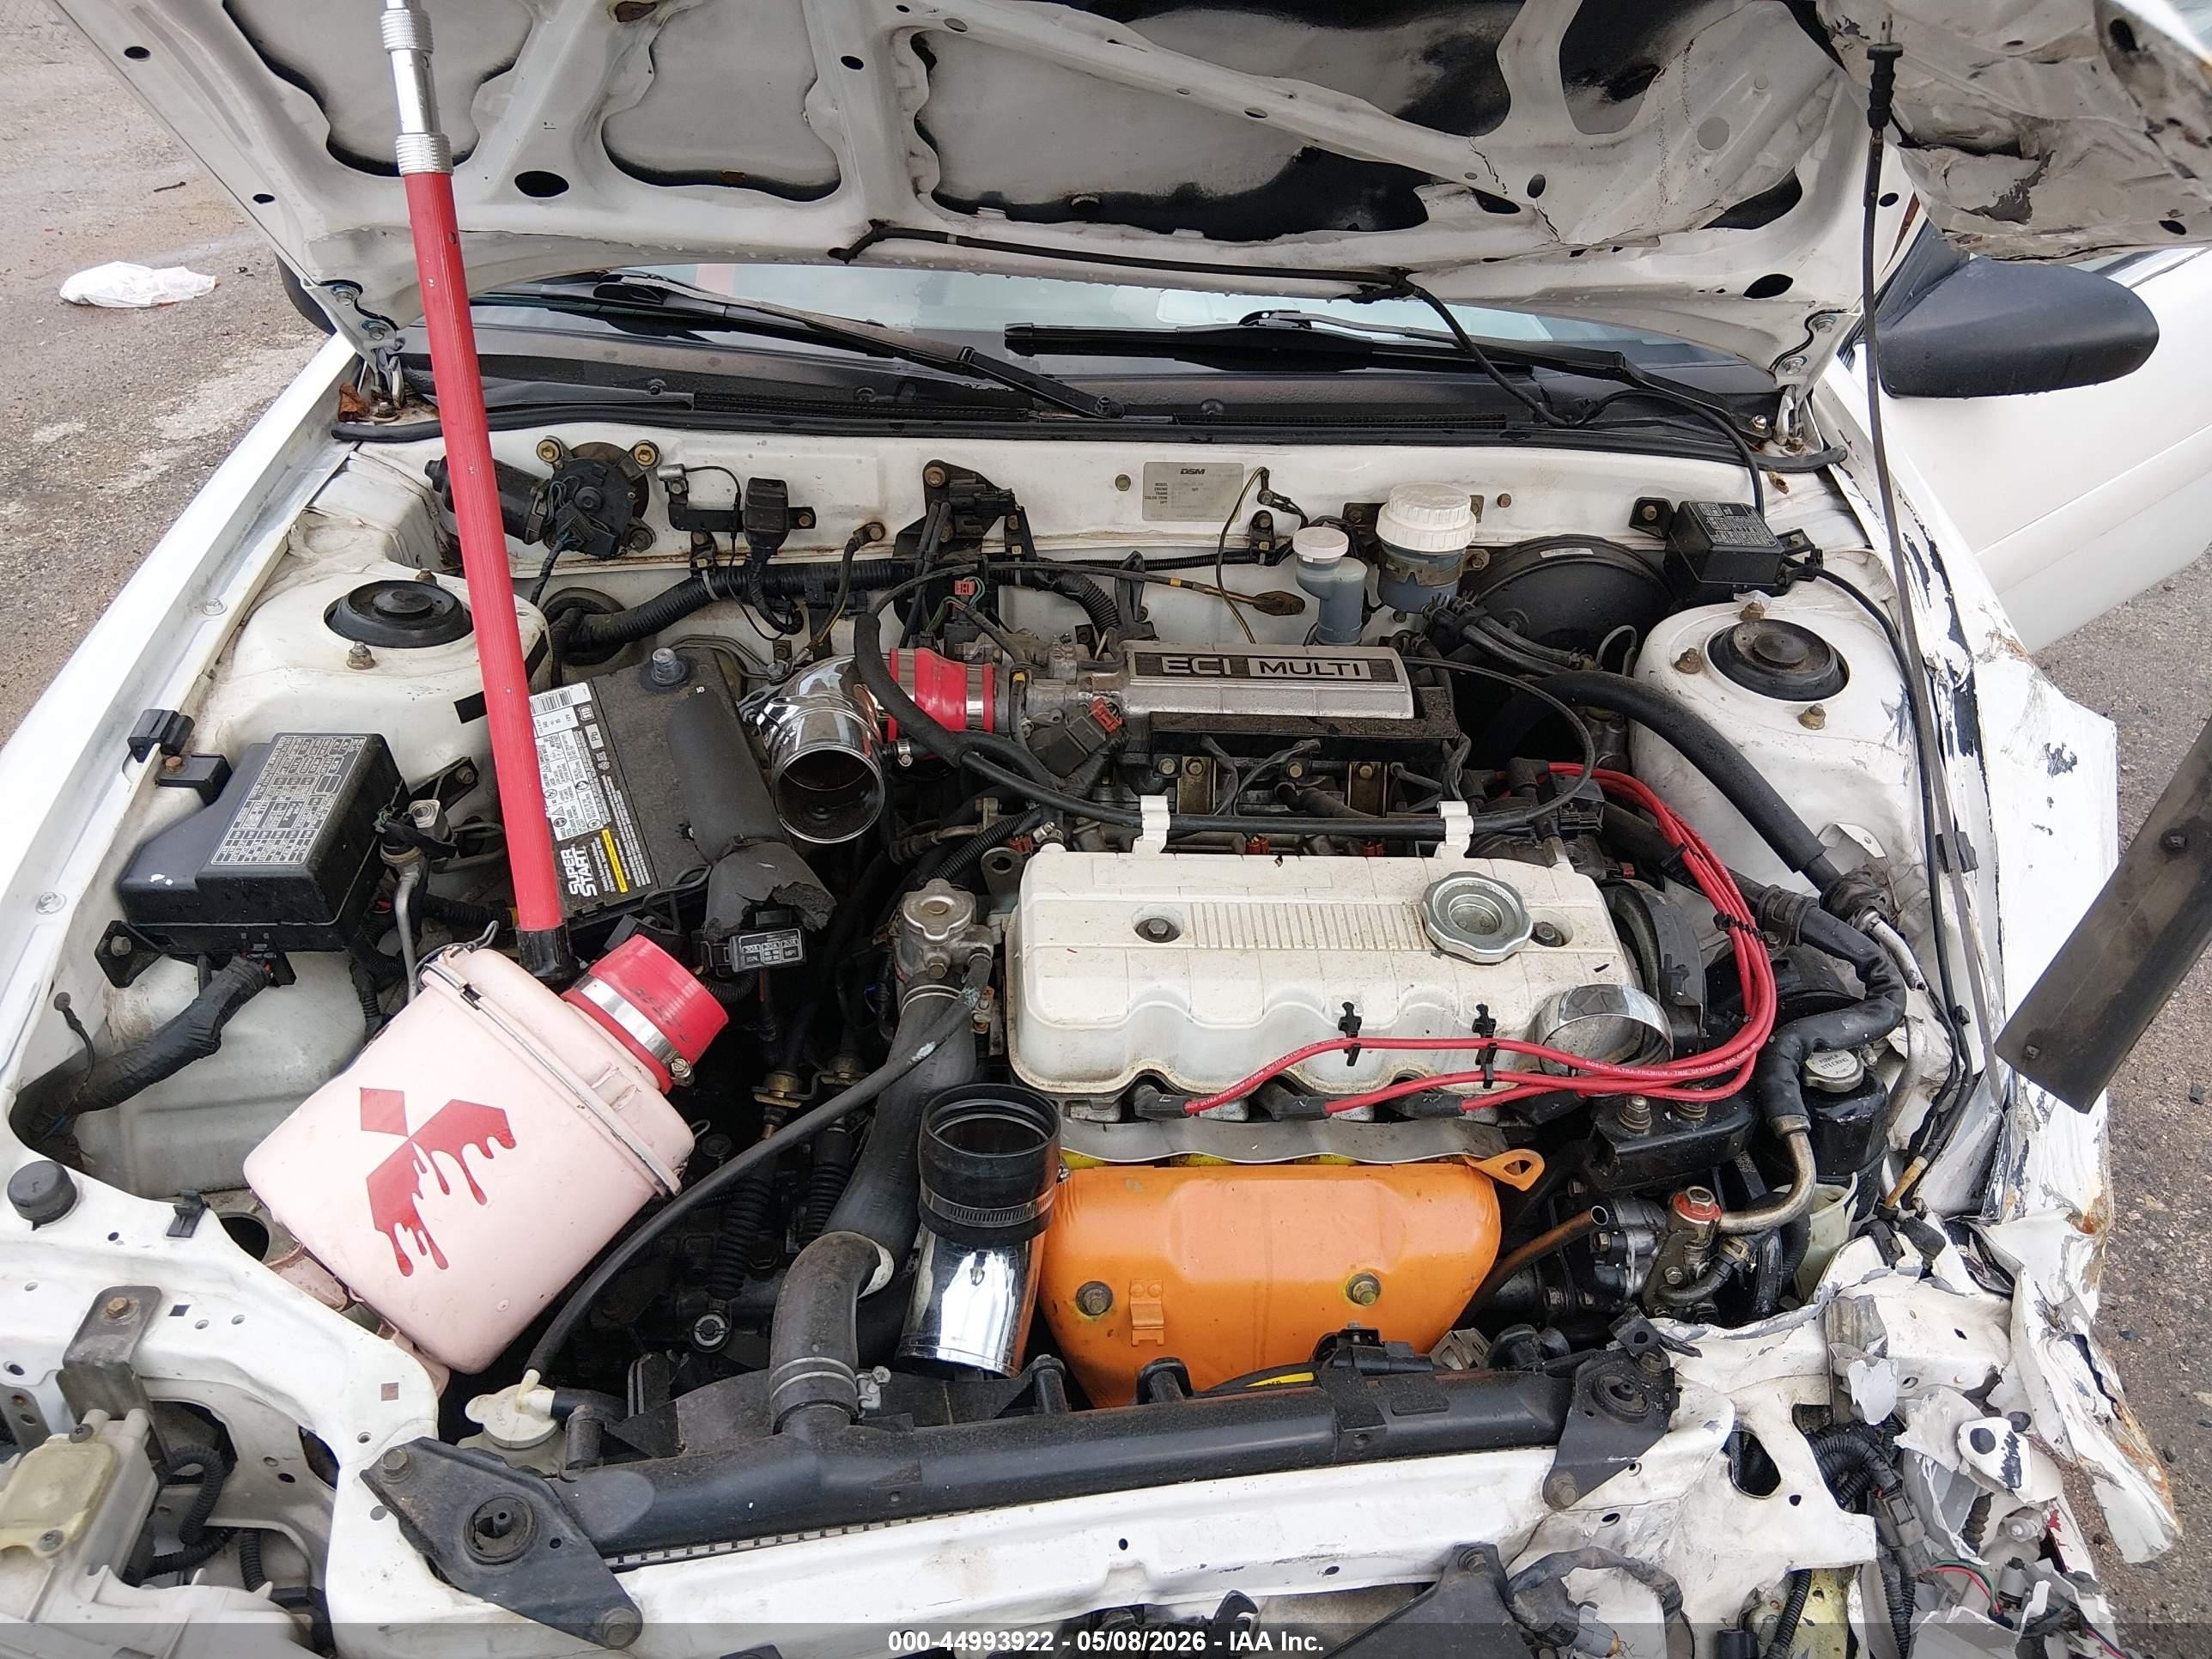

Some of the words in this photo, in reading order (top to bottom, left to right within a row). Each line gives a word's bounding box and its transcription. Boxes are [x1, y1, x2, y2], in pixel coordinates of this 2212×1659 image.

[1162, 655, 1231, 676] ECI
[1260, 659, 1361, 677] MULTI
[591, 731, 600, 742] Pb
[560, 849, 581, 895] SUPER
[571, 846, 599, 897] START
[1585, 1060, 1609, 1070] BOSCH
[1613, 1066, 1668, 1076] ULTRA-PREMIUM
[1200, 1083, 1245, 1106] ULTRA-PREMIUM
